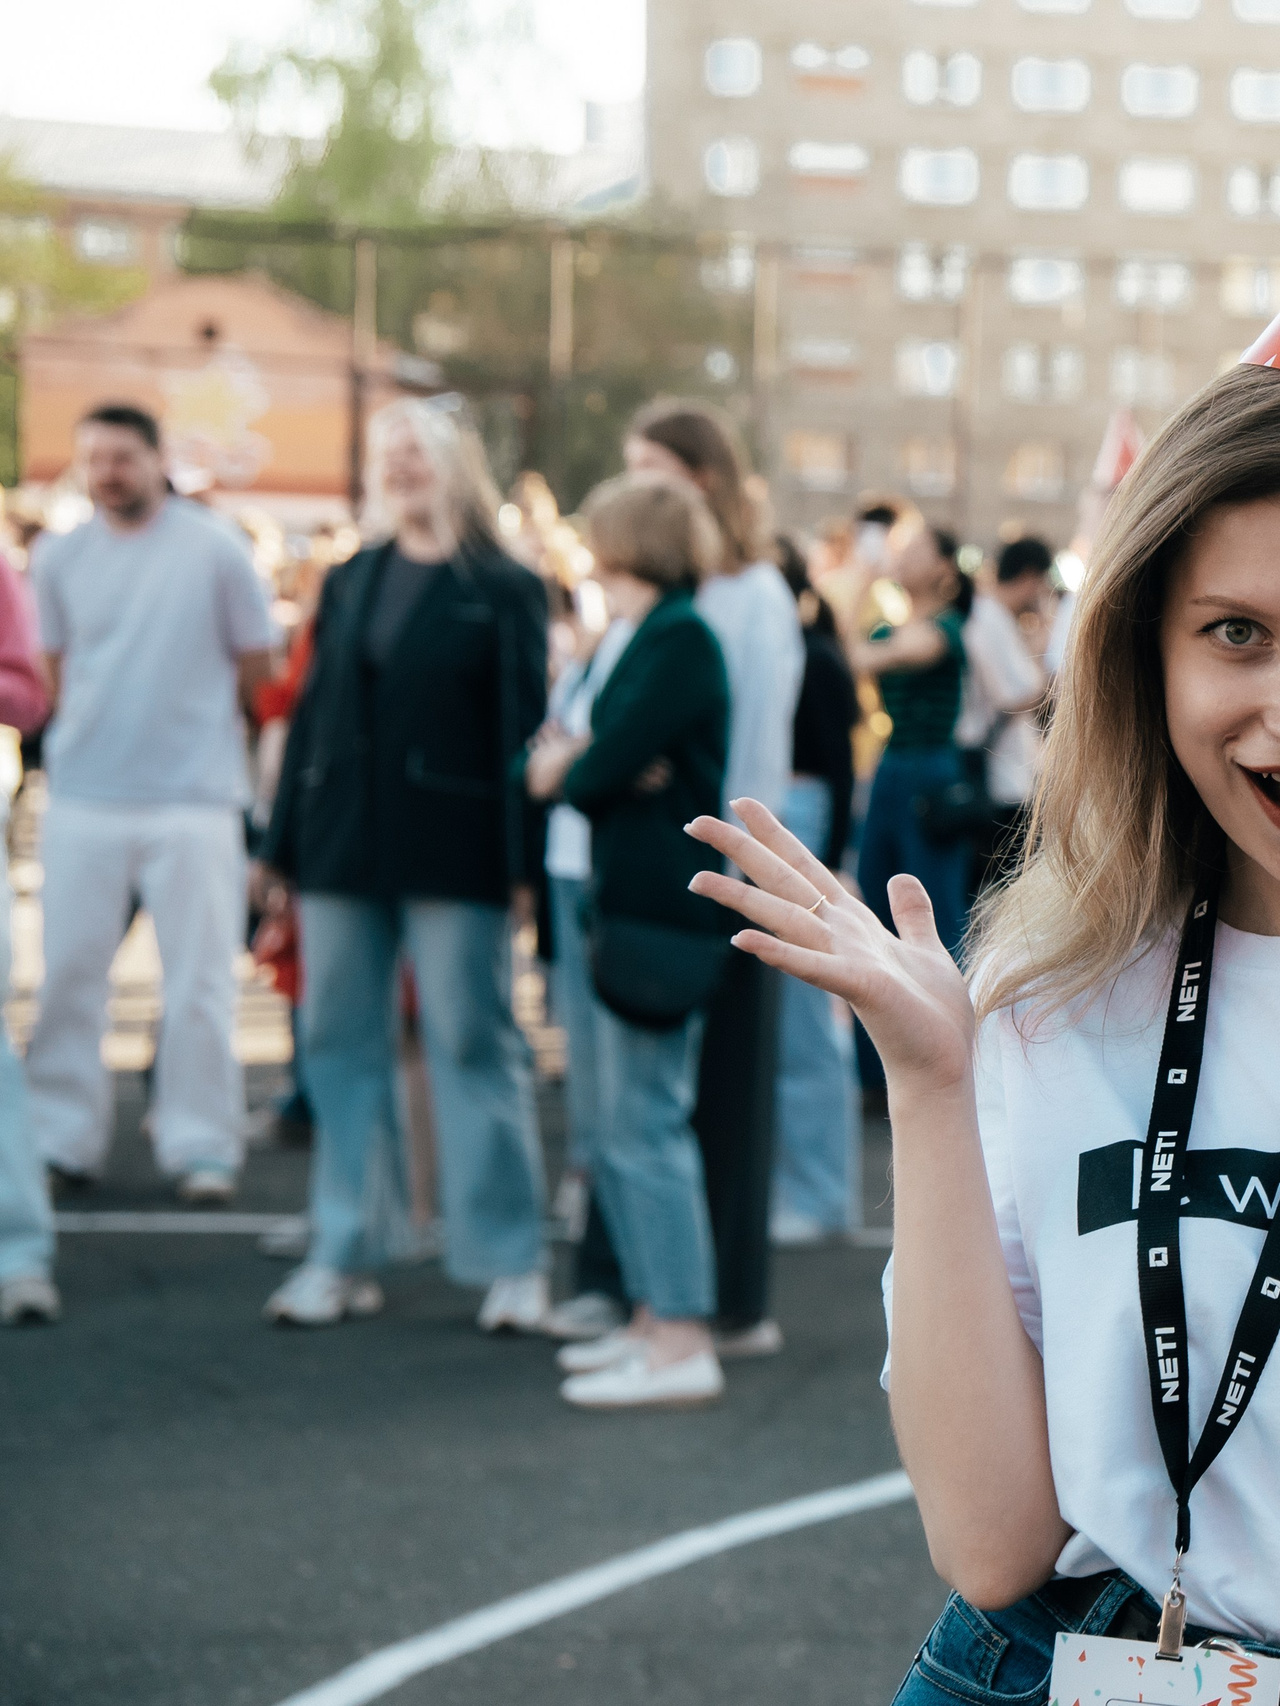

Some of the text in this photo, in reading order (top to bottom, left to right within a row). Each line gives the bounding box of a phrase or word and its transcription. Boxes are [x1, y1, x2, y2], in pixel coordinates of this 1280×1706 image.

[1176, 961, 1202, 1022] NETI
[1150, 1131, 1178, 1192] NETI
[1155, 1326, 1180, 1403] NETI
[1216, 1351, 1256, 1426] NETI
